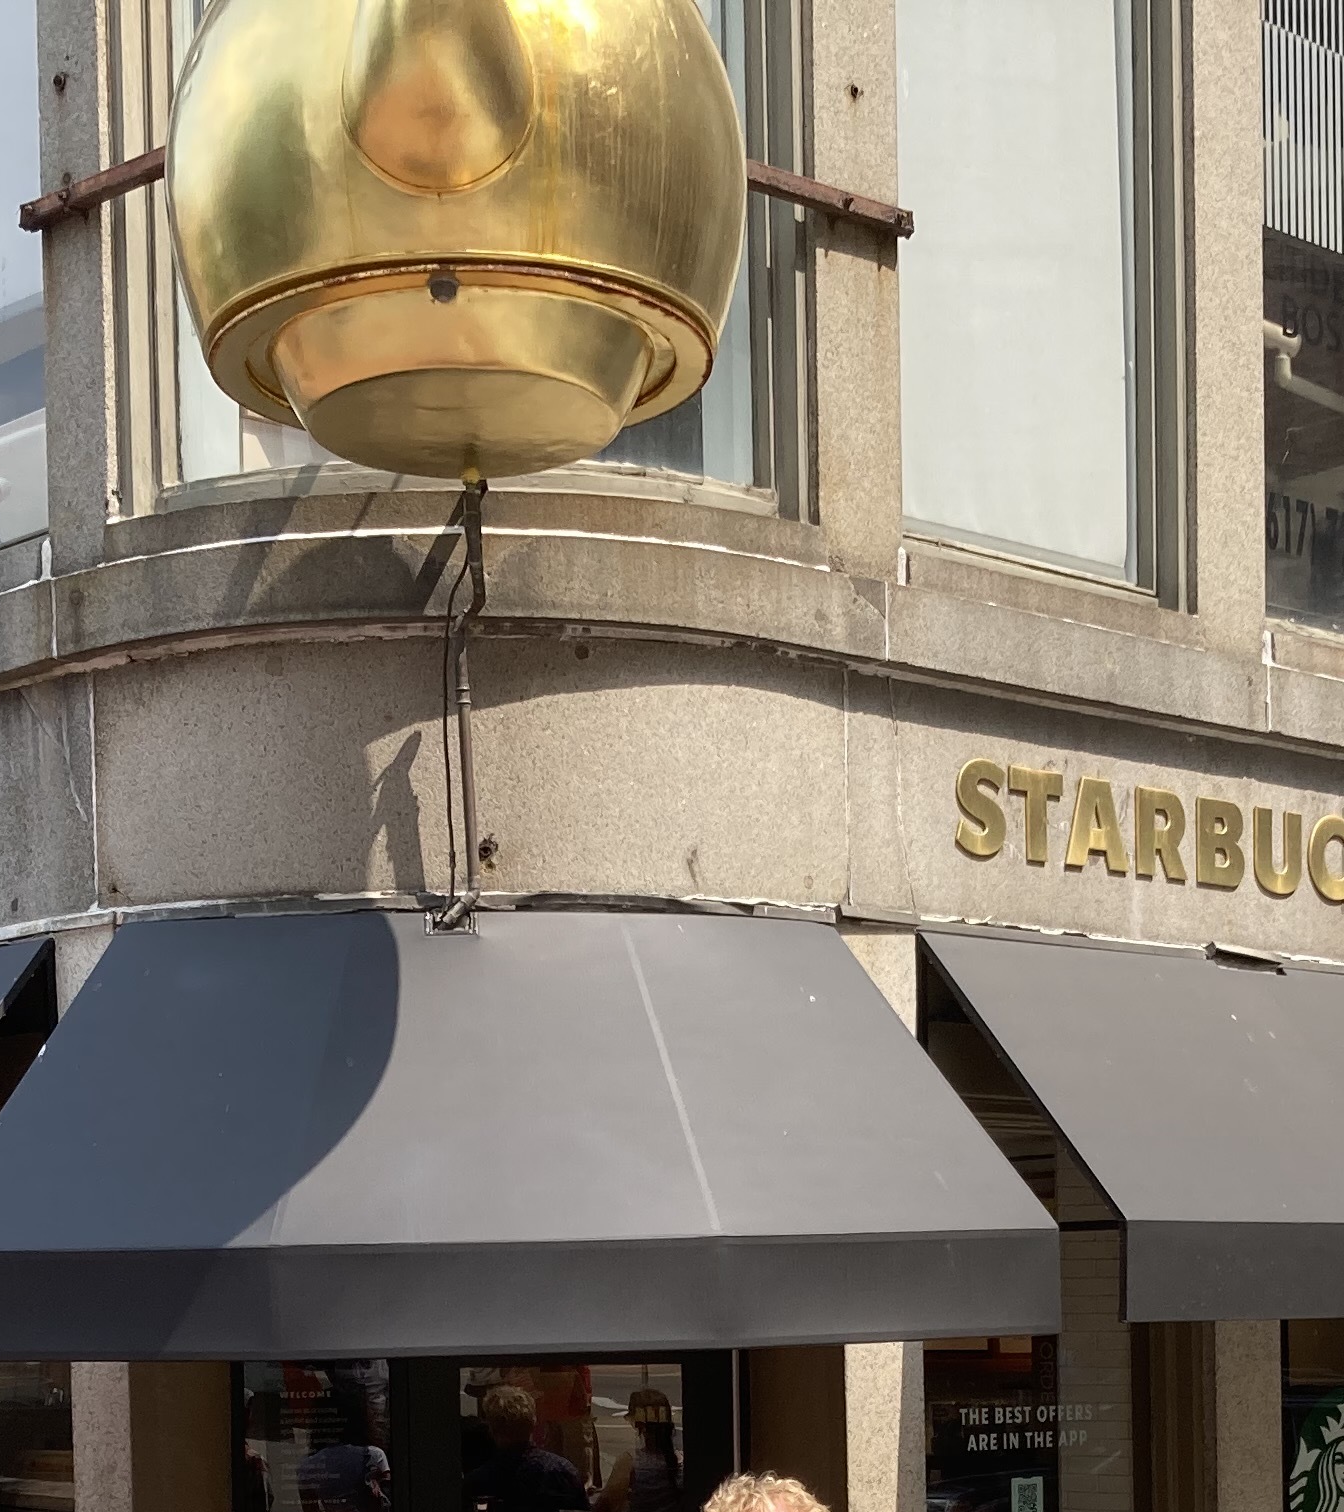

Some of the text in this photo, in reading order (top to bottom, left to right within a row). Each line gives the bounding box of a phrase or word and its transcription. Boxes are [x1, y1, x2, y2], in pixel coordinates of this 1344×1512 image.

[280, 1390, 332, 1399] WELCOME
[959, 1404, 1093, 1425] THE BEST OFFERS
[967, 1430, 1088, 1451] ARE IN THE APP
